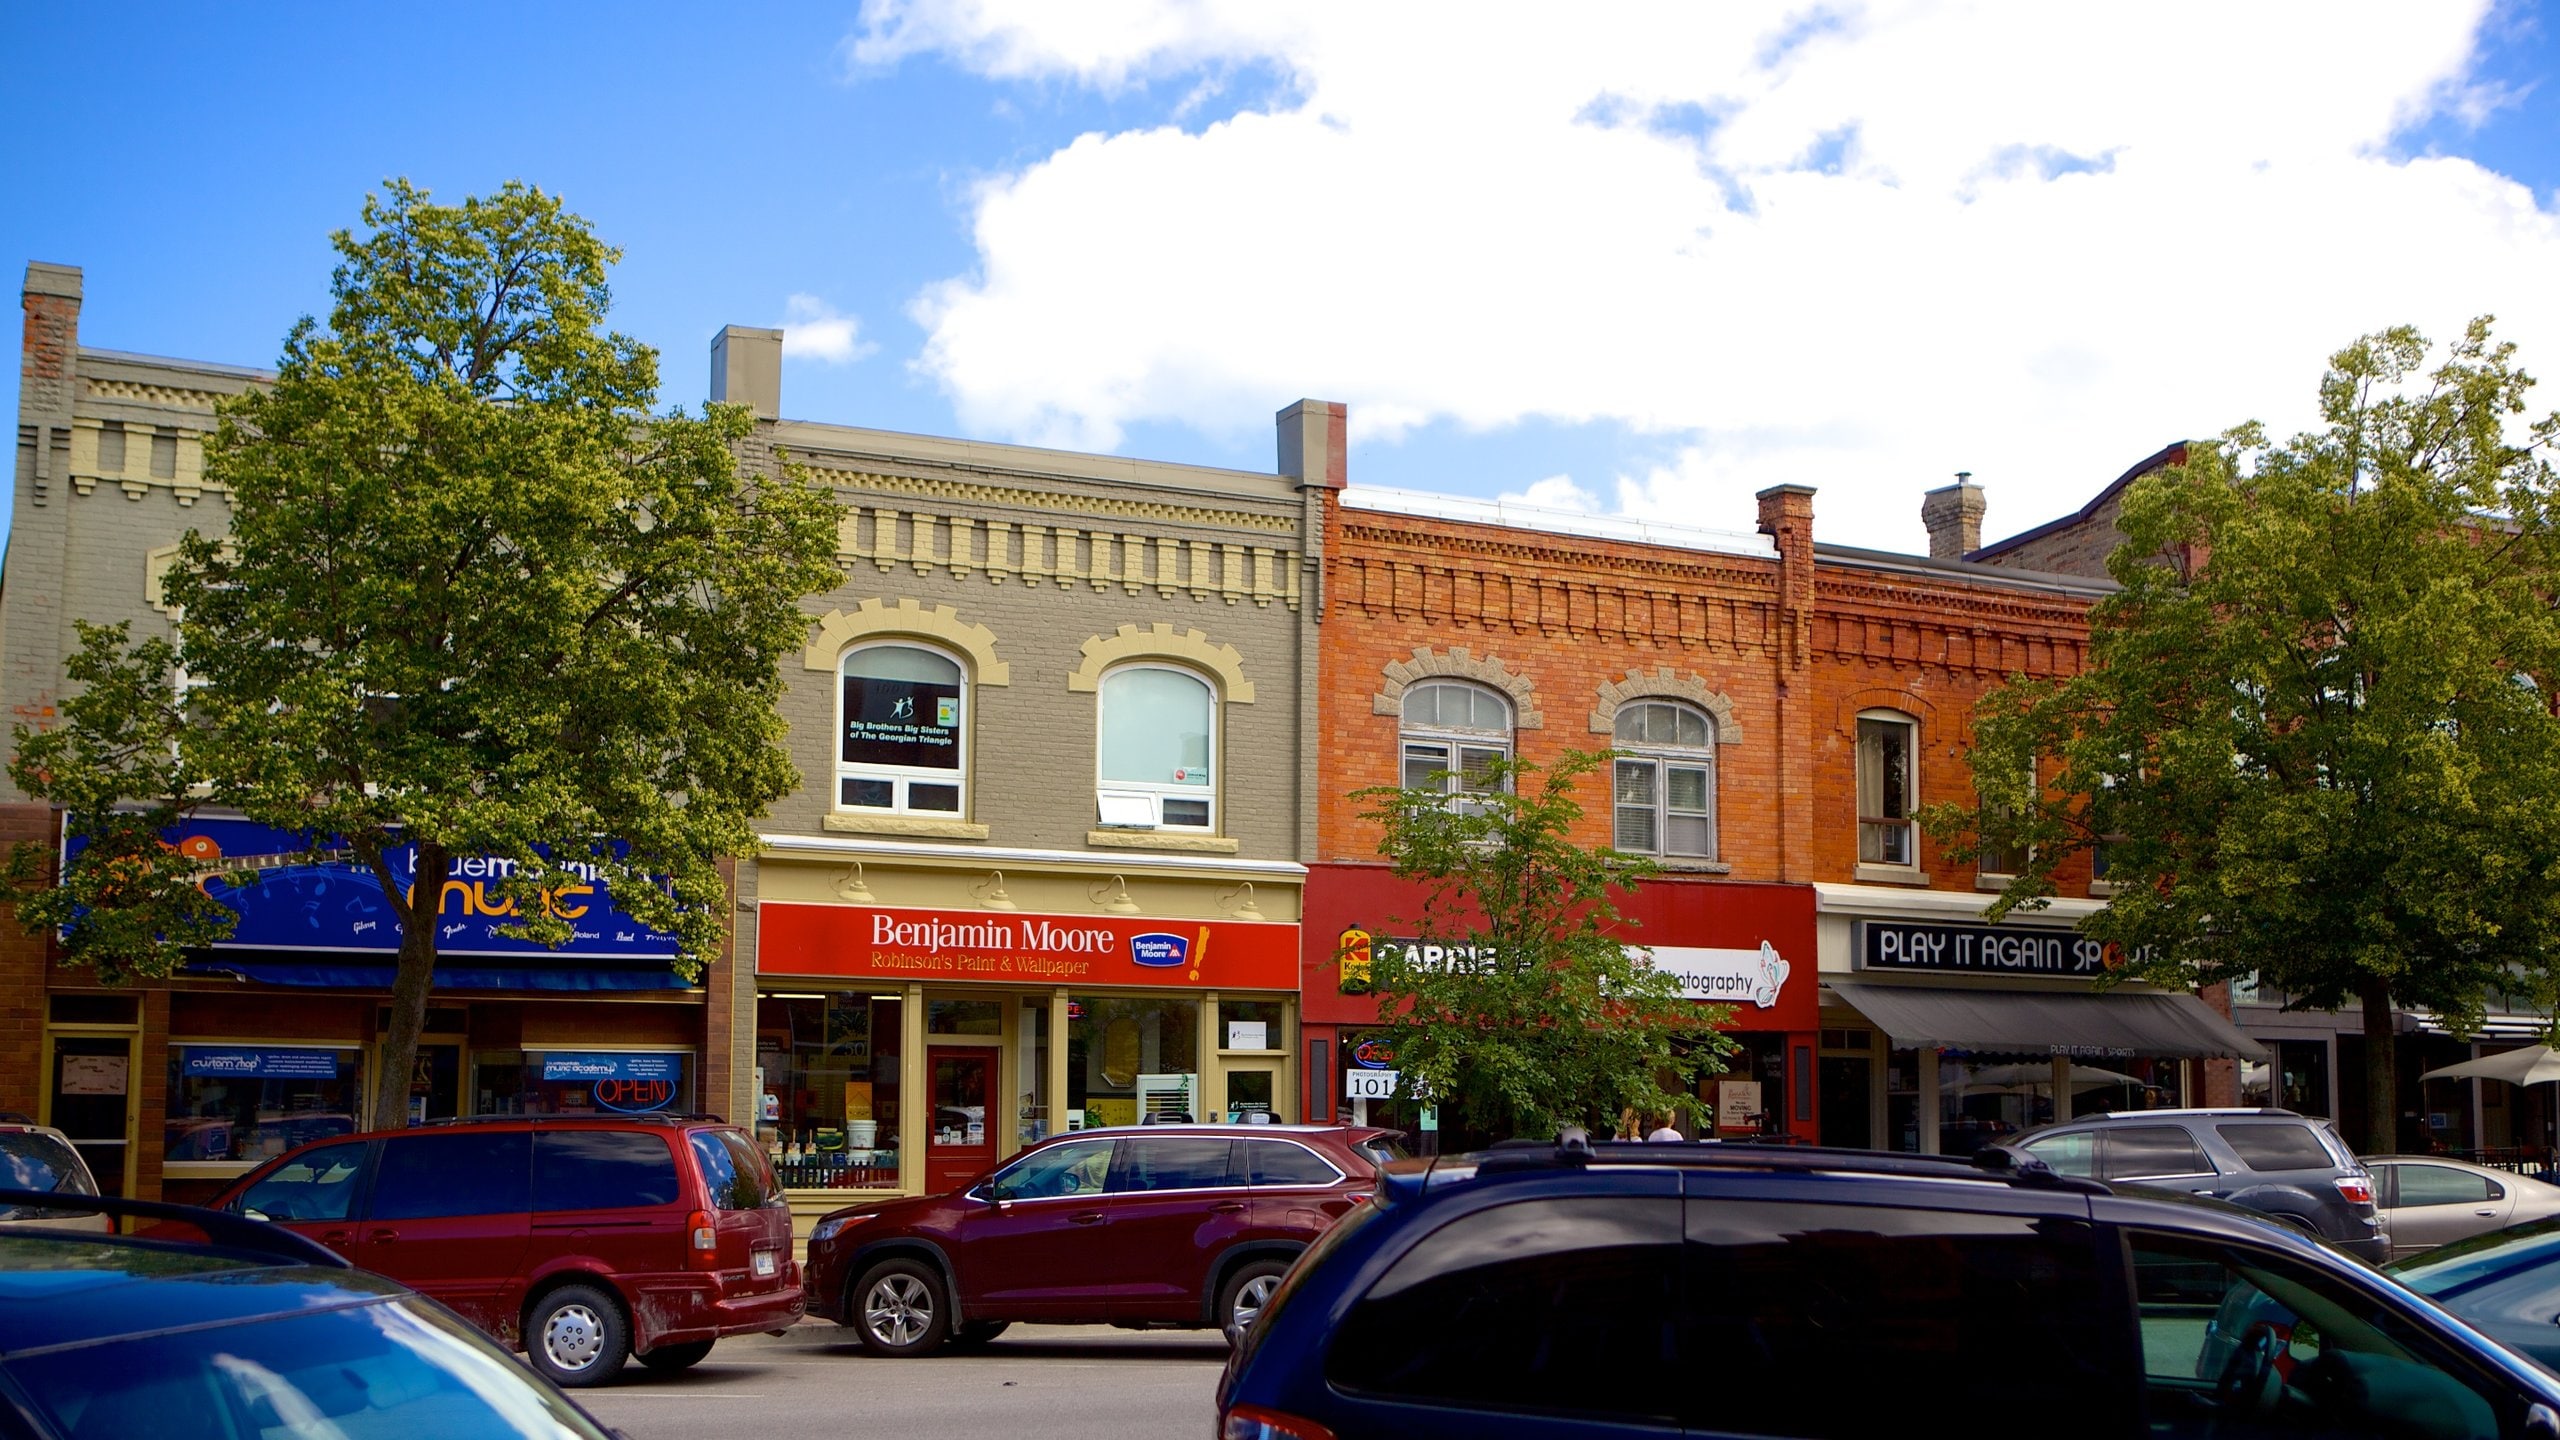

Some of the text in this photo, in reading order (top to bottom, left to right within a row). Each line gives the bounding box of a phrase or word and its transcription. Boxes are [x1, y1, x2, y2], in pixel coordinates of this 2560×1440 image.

[850, 721, 949, 735] Big Brothers Big Sisters
[850, 731, 952, 745] of The Georgian Triangle
[574, 931, 599, 939] Roland
[871, 914, 1114, 953] Benjamin Moore
[1135, 941, 1171, 951] Benjamin
[1881, 930, 1945, 963] PLAY
[1956, 934, 1974, 965] IT
[1982, 935, 2062, 969] AGAIN
[1141, 950, 1165, 958] Moore
[871, 951, 1089, 977] Robinson's Paint & Wallpaper
[2050, 1045, 2135, 1056] PLAY IT AGAIN SPORTS
[192, 1056, 257, 1072] custom shop
[572, 1064, 612, 1075] academy
[598, 1078, 666, 1102] OPEN
[1354, 1078, 1390, 1096] 101
